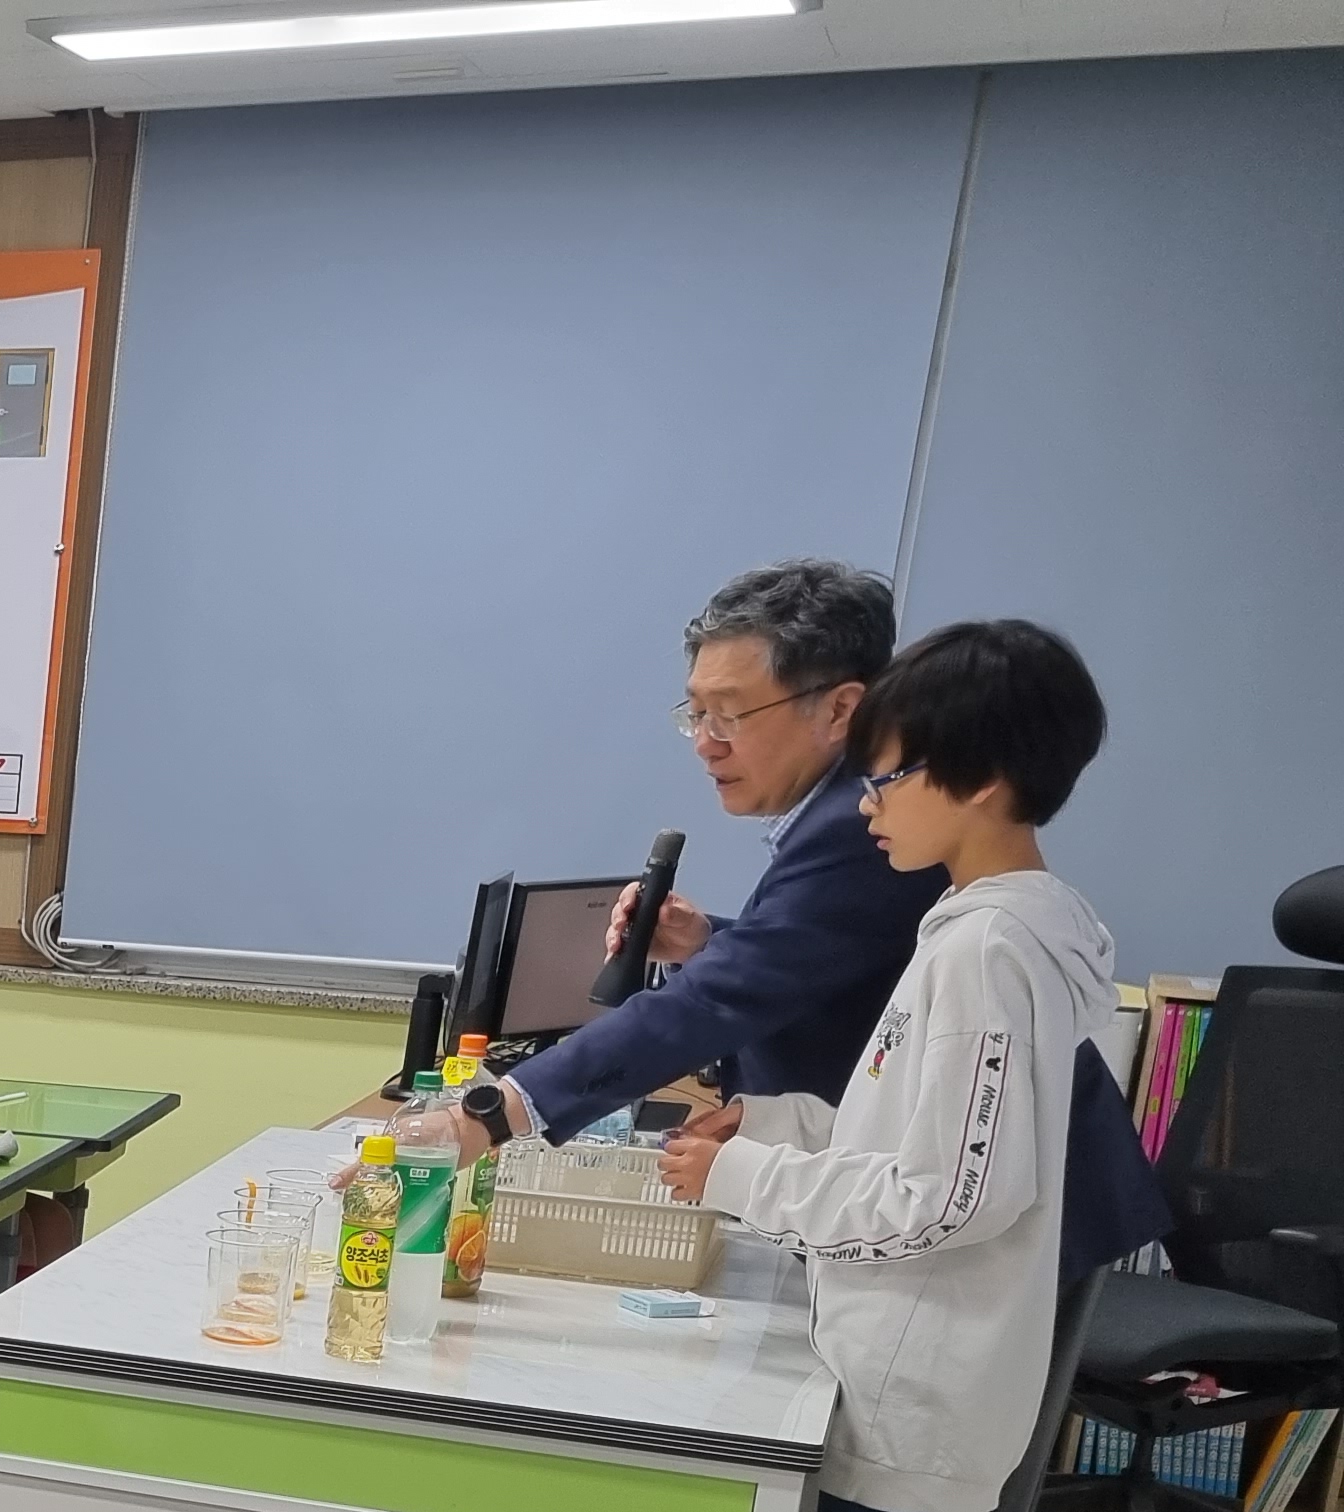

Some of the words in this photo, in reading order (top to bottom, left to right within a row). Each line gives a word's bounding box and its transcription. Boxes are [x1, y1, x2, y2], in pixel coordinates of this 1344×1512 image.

[976, 1083, 997, 1129] Mouse
[952, 1168, 980, 1214] Mickey
[346, 1245, 389, 1264] 양조식초
